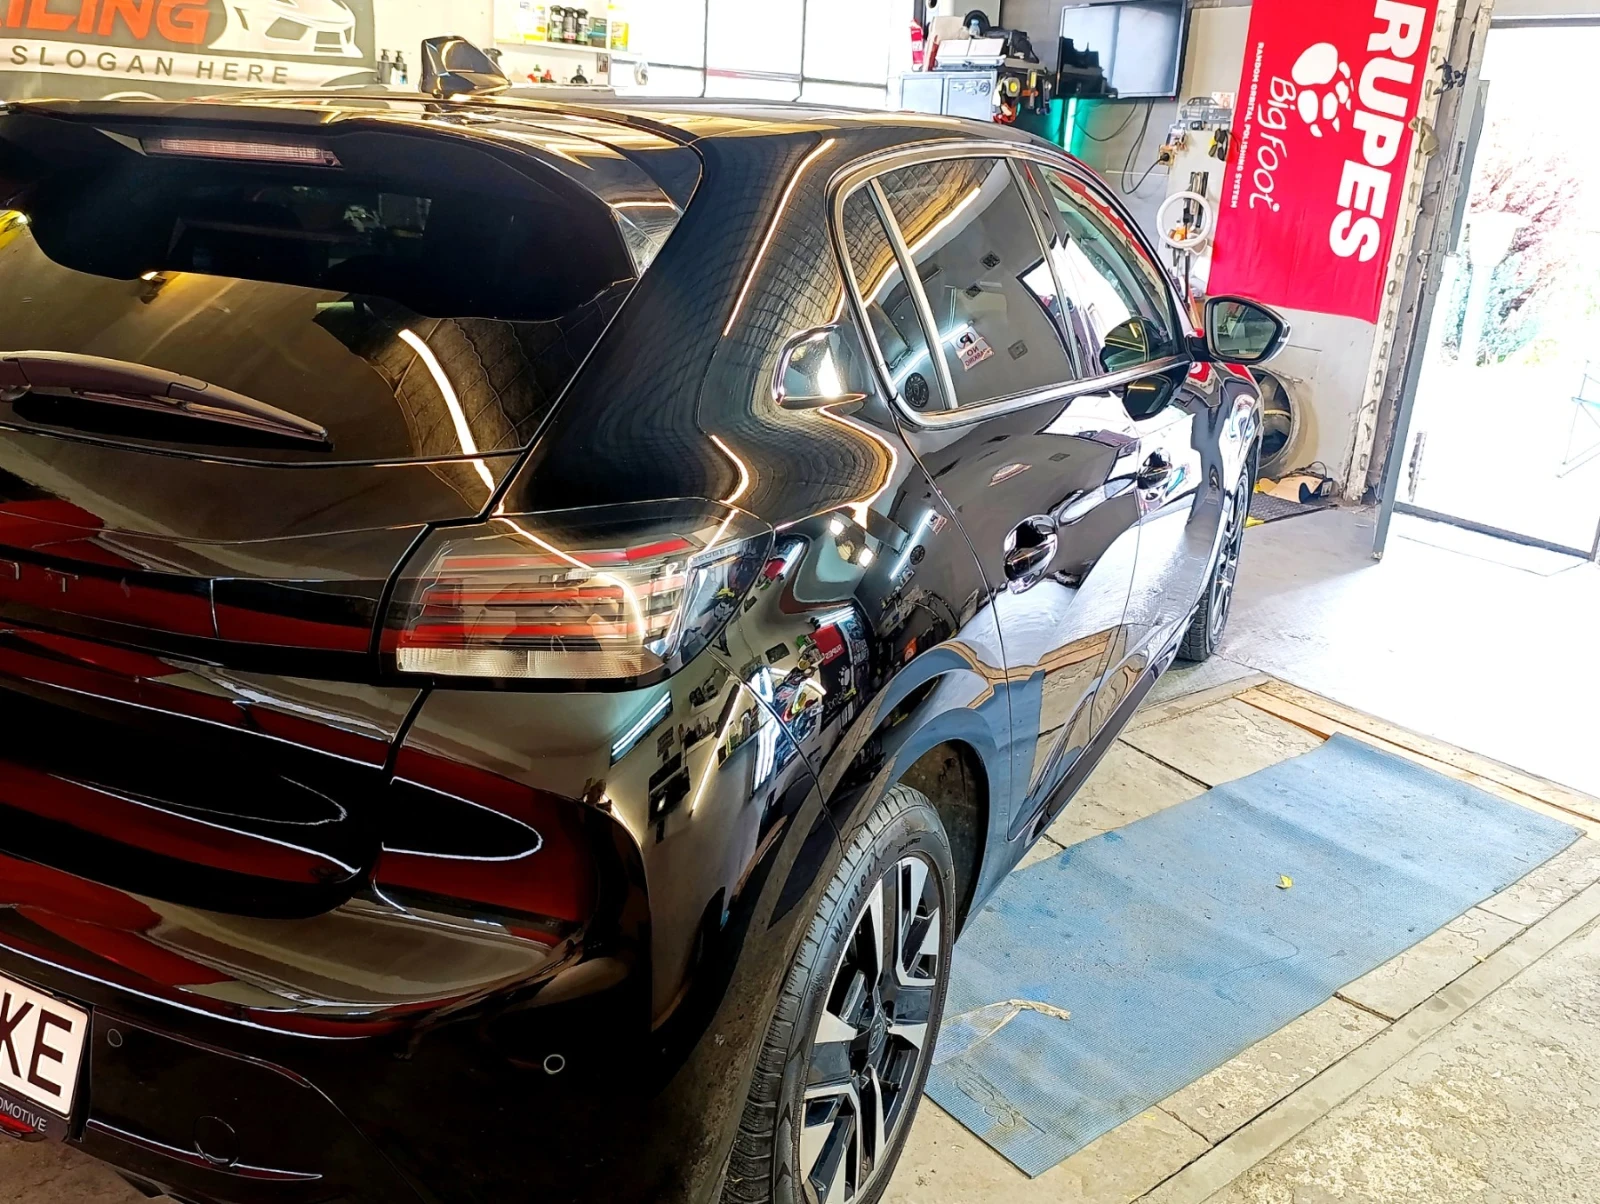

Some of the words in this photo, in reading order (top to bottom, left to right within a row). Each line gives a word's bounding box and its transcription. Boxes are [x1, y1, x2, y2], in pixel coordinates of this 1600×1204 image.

[0, 0, 210, 44] ILING
[10, 45, 174, 76] SLOGAN
[196, 60, 290, 85] HERE
[1252, 42, 1265, 82] RANDOM
[1244, 83, 1258, 122] ORBITAL
[1236, 123, 1251, 171] POLISHING
[1329, 0, 1427, 262] RUPES
[1230, 173, 1243, 208] SYSTEM
[0, 991, 74, 1098] KE
